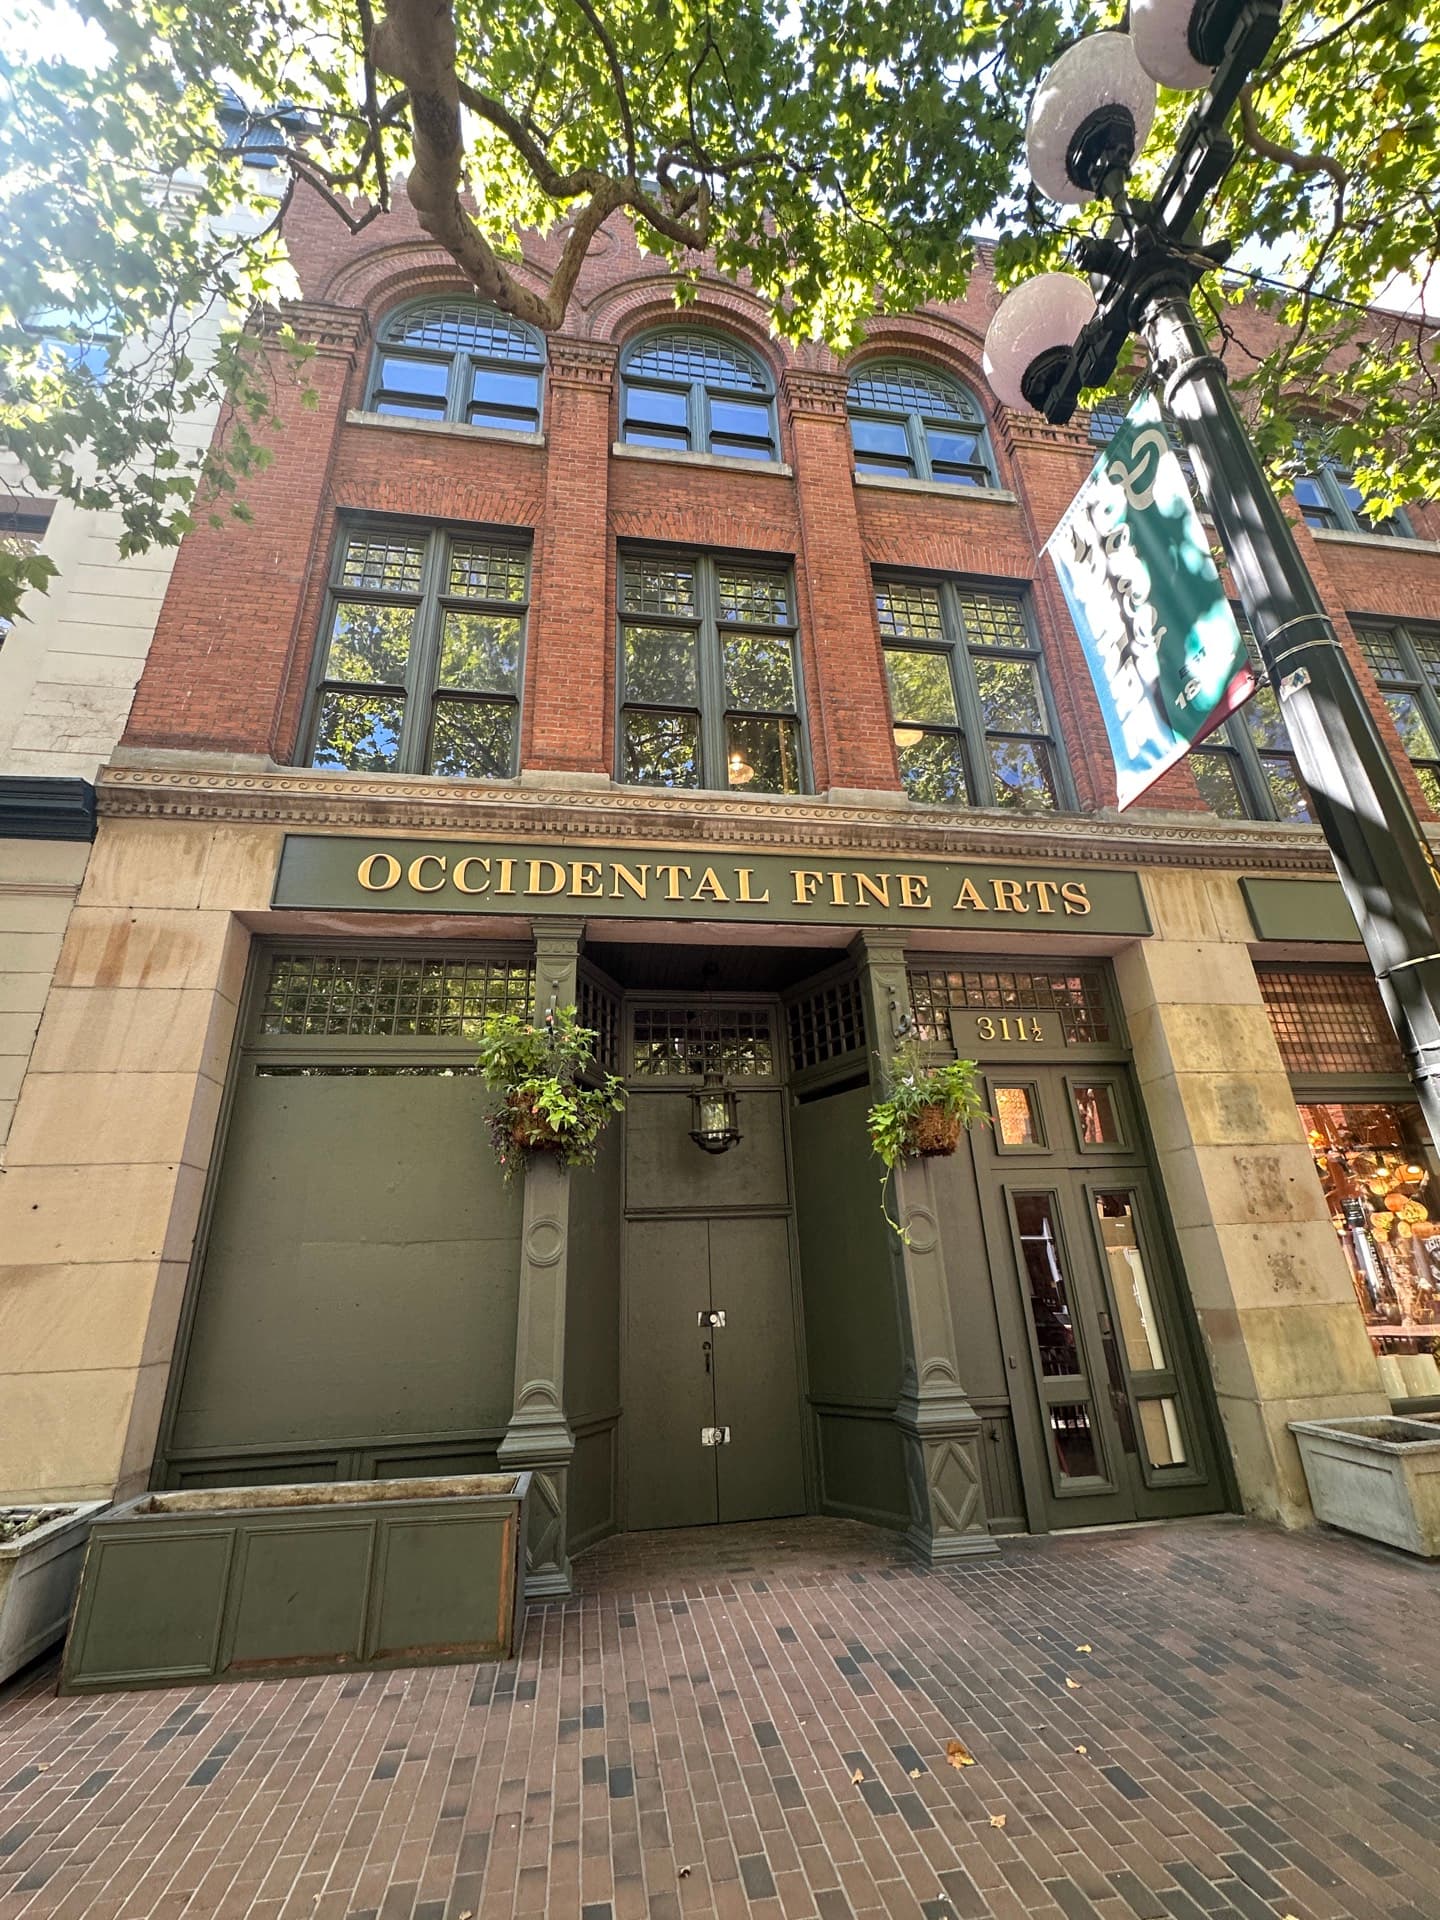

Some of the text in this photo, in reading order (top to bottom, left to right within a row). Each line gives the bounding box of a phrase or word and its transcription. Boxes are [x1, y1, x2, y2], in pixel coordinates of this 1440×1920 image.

[357, 853, 1091, 915] OCCIDENTAL FINE ARTS
